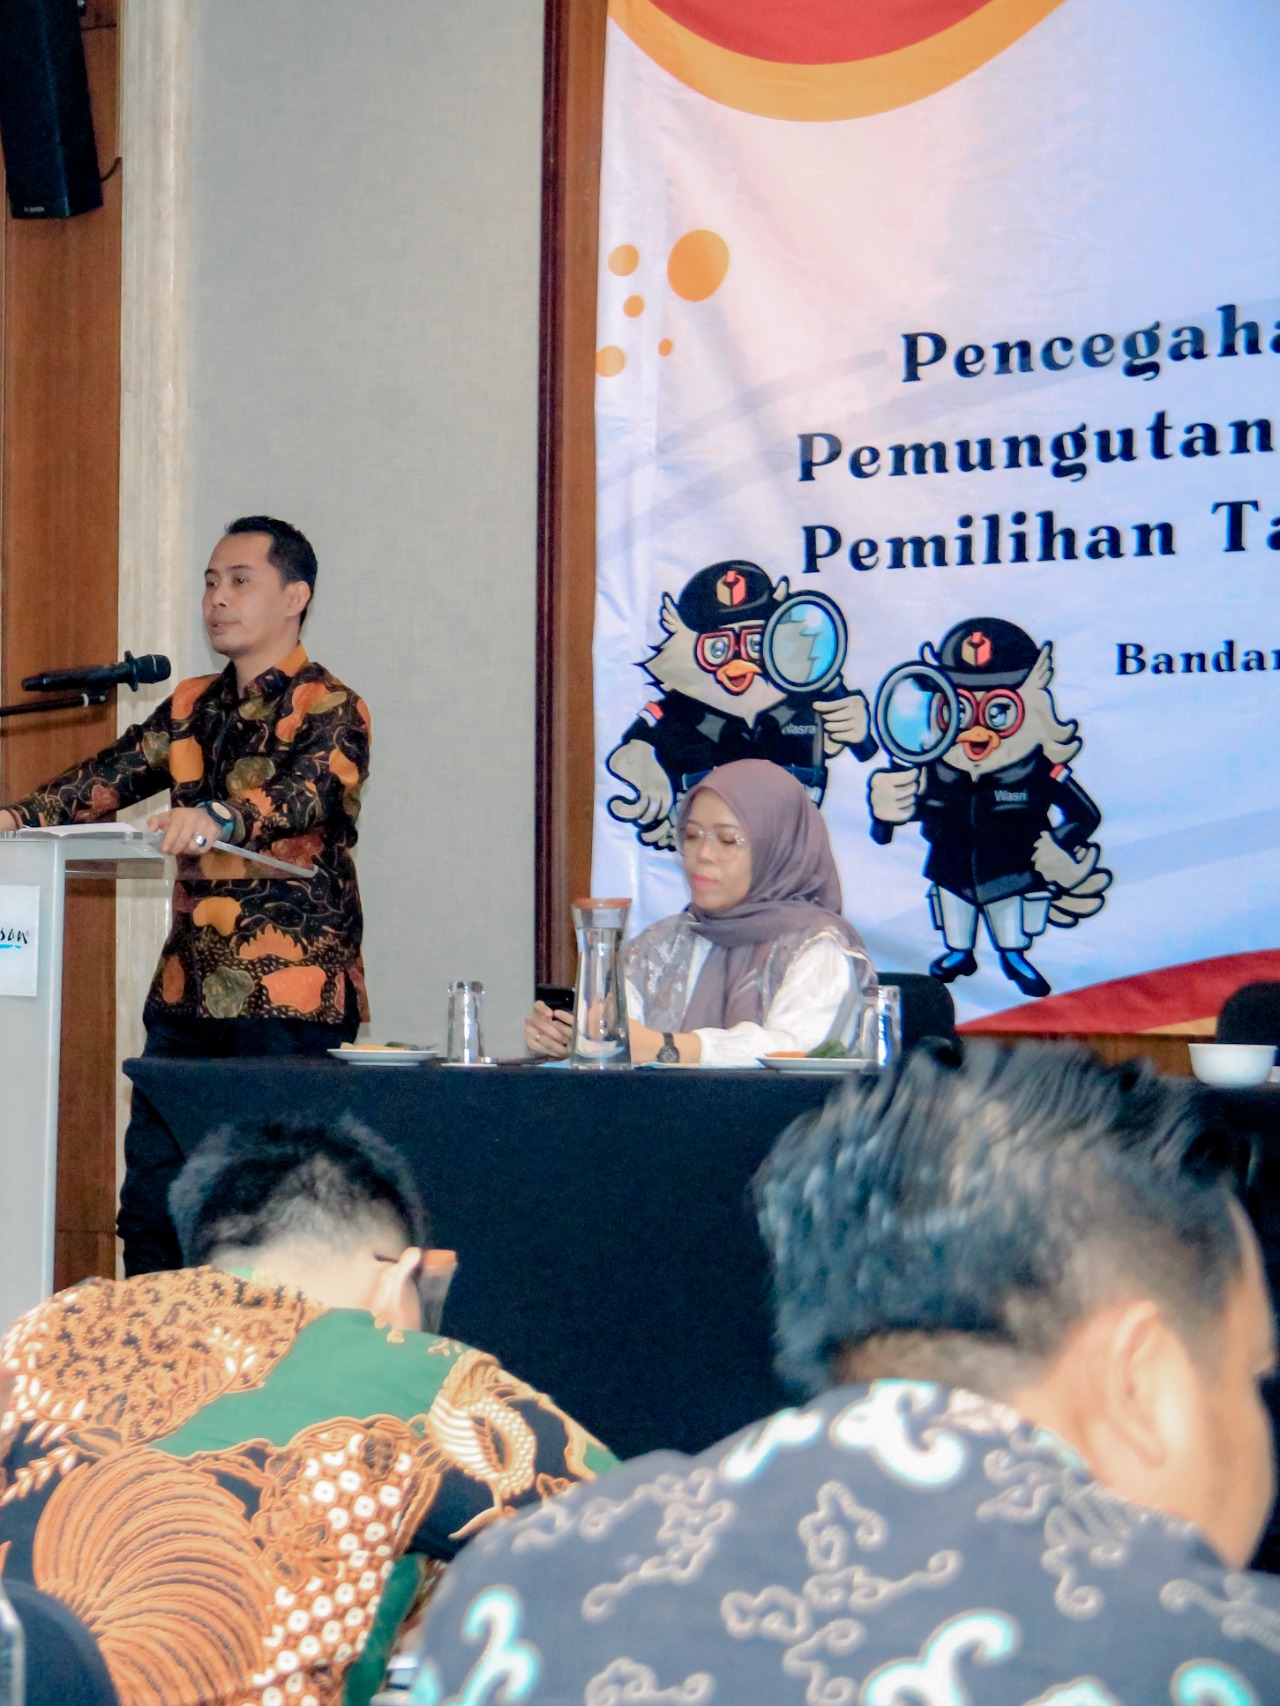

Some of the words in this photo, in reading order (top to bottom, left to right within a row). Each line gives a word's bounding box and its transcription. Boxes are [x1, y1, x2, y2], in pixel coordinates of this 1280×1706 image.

[901, 303, 1280, 383] Pencegah
[797, 410, 1275, 483] Pemungutan
[802, 510, 1177, 574] Pemilihan
[993, 789, 1028, 802] Wasri
